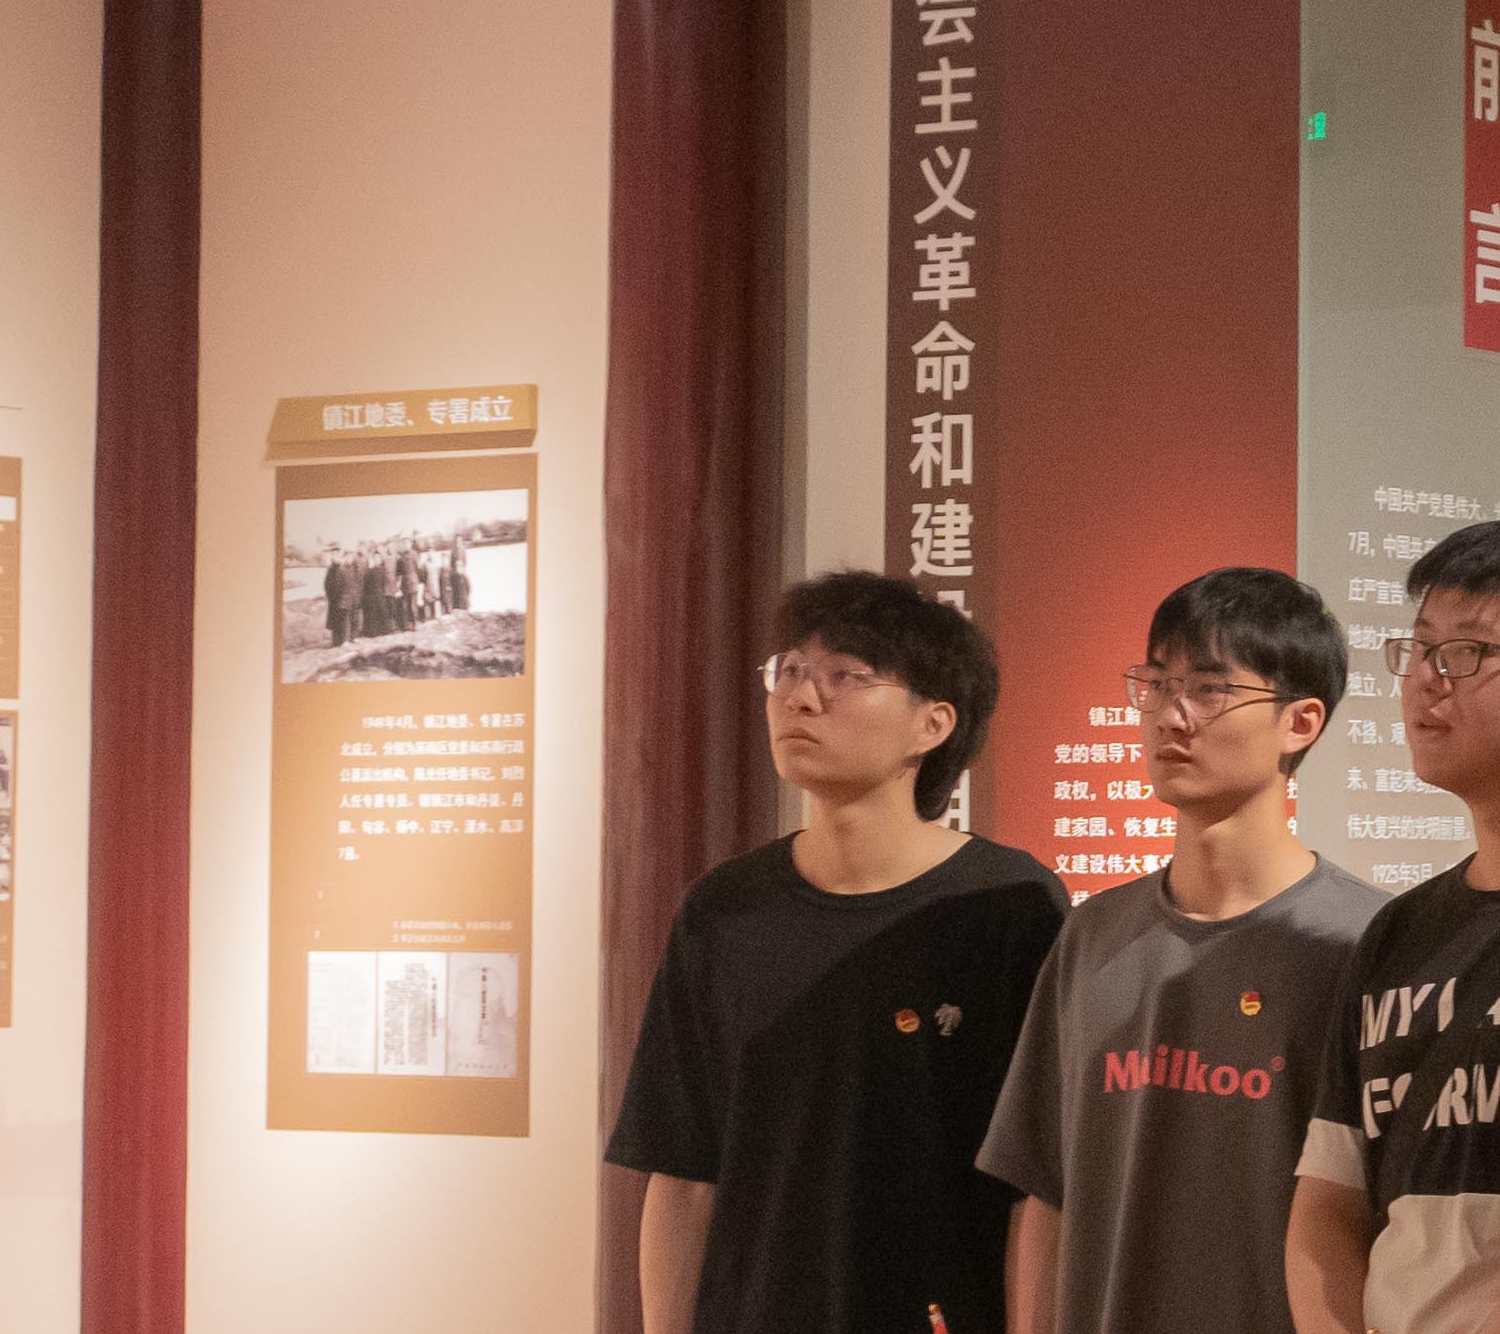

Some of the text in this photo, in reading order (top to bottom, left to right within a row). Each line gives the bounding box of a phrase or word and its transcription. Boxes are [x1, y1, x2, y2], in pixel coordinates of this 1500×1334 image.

[1054, 742, 1144, 764] 党的领导下
[1053, 817, 1178, 838] 建家园、恢复生
